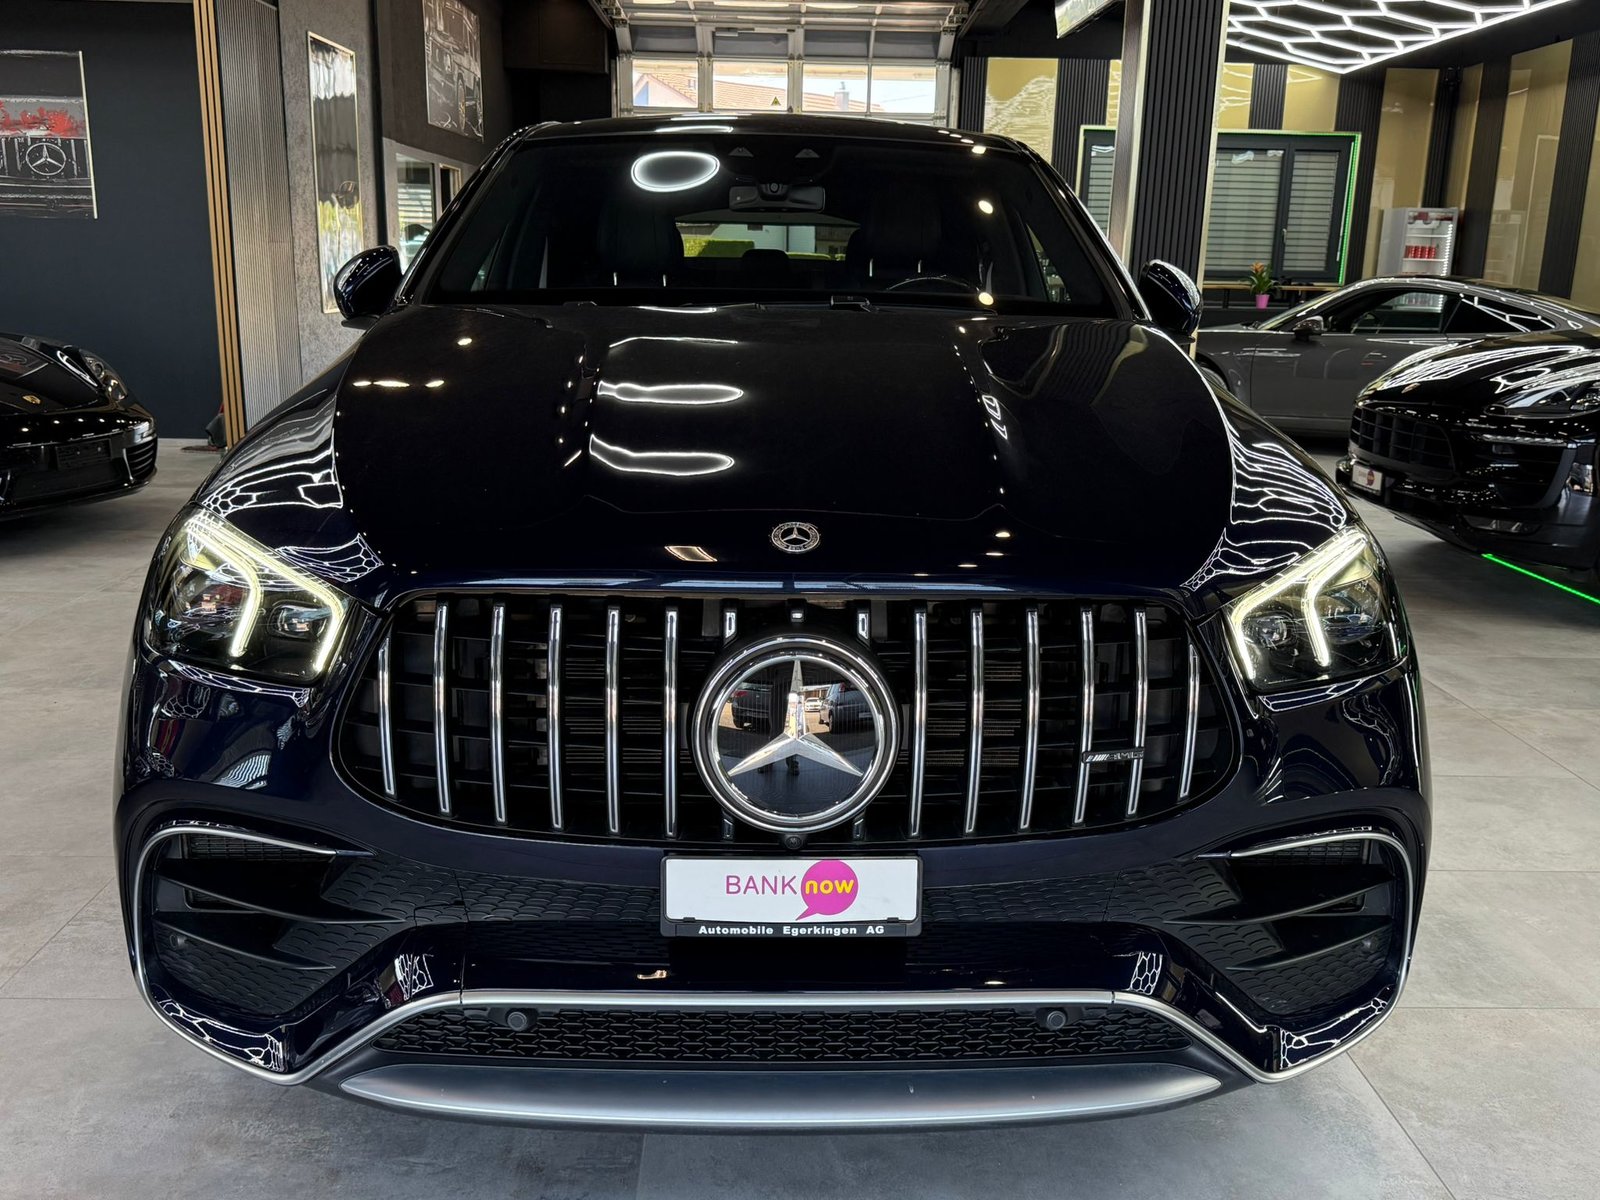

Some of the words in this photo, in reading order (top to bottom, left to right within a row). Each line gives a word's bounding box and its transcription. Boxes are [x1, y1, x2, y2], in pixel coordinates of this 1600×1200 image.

[725, 875, 798, 896] BANK
[804, 879, 856, 895] now
[698, 925, 774, 935] Automobile
[782, 925, 857, 937] Egerkingen
[865, 925, 885, 935] AG
